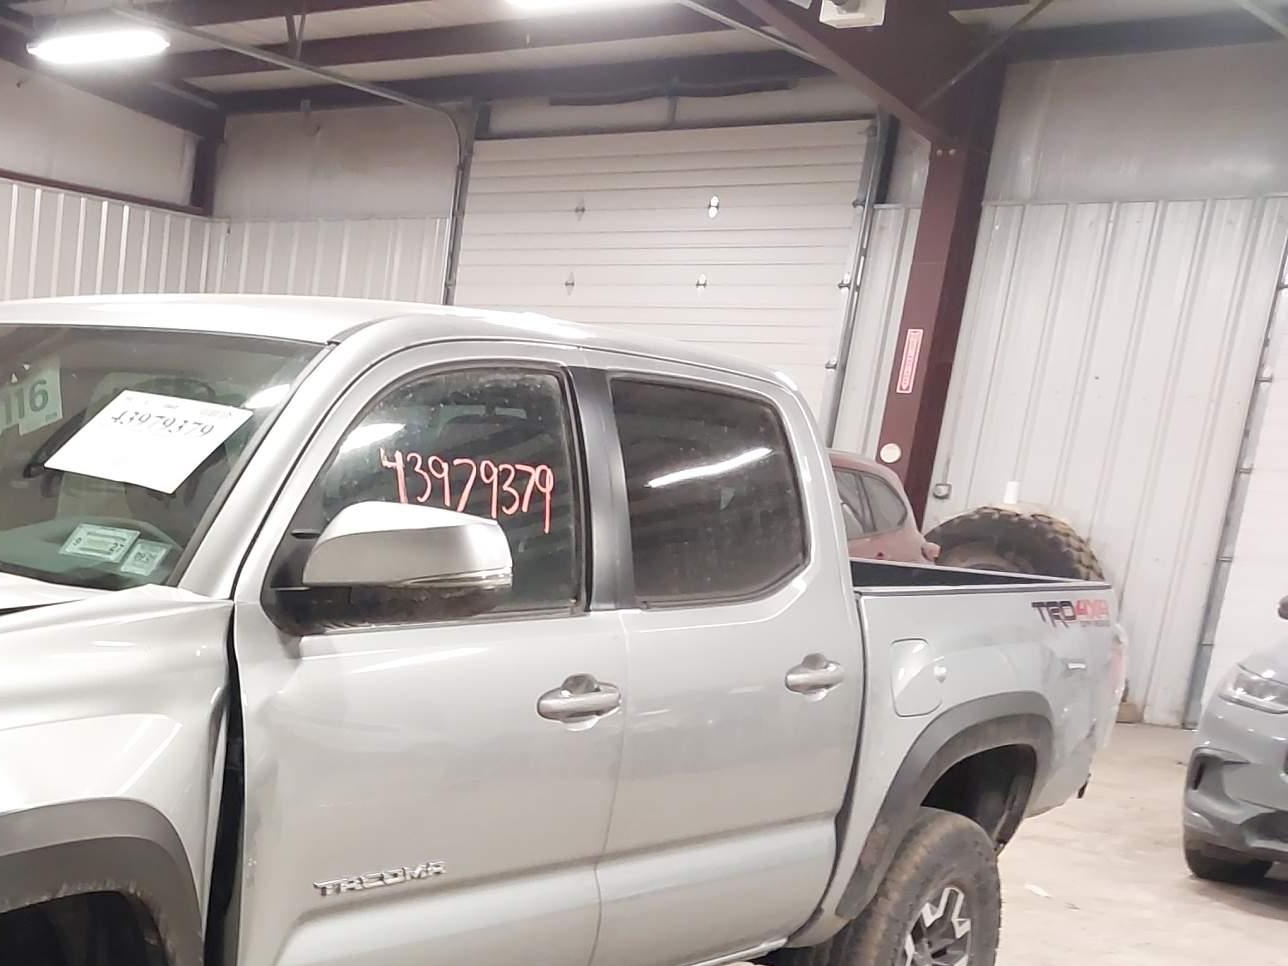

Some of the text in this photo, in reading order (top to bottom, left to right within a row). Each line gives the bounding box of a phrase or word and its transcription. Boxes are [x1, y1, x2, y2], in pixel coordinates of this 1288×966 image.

[111, 409, 215, 437] 43979379
[380, 447, 554, 534] 43979379
[1031, 600, 1077, 629] TRD
[312, 860, 448, 897] TACOMA
